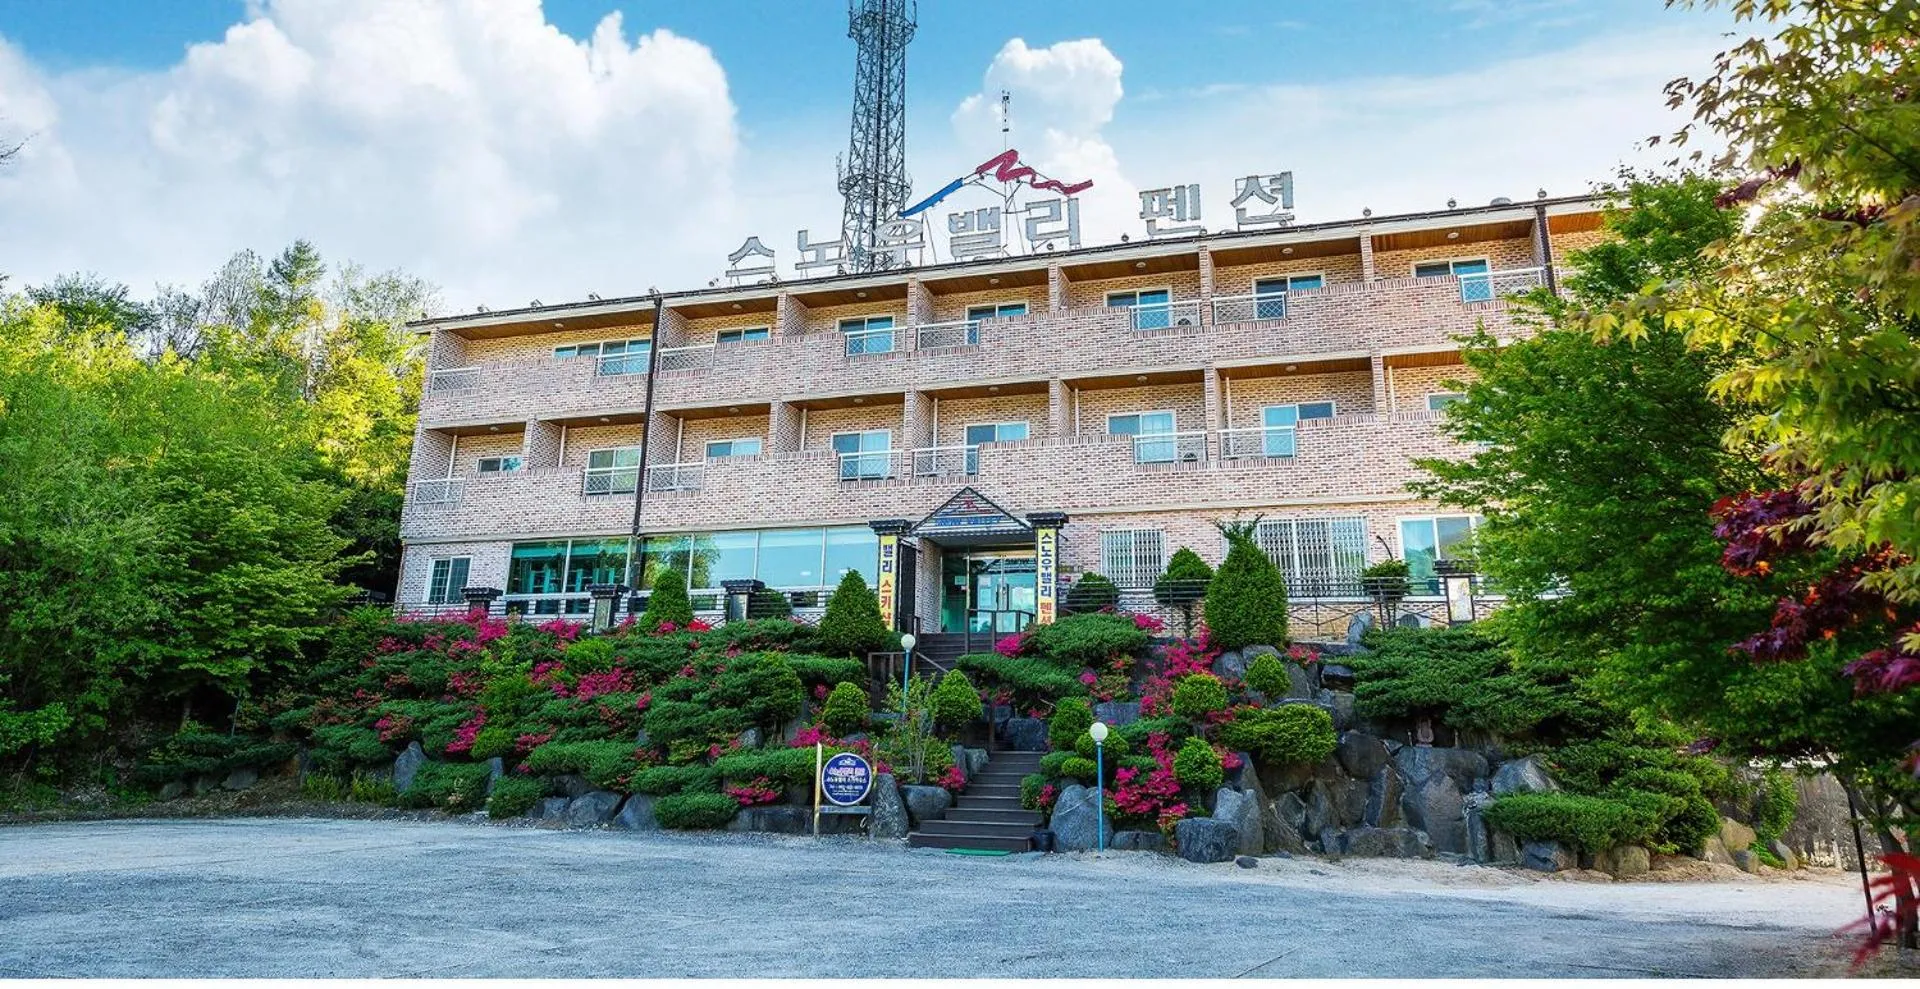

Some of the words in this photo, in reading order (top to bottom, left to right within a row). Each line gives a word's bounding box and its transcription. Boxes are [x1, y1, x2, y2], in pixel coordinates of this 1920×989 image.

[725, 198, 1082, 276] 스노우밸리
[1138, 171, 1295, 236] 펜션
[1040, 532, 1053, 597] 스노우밸리
